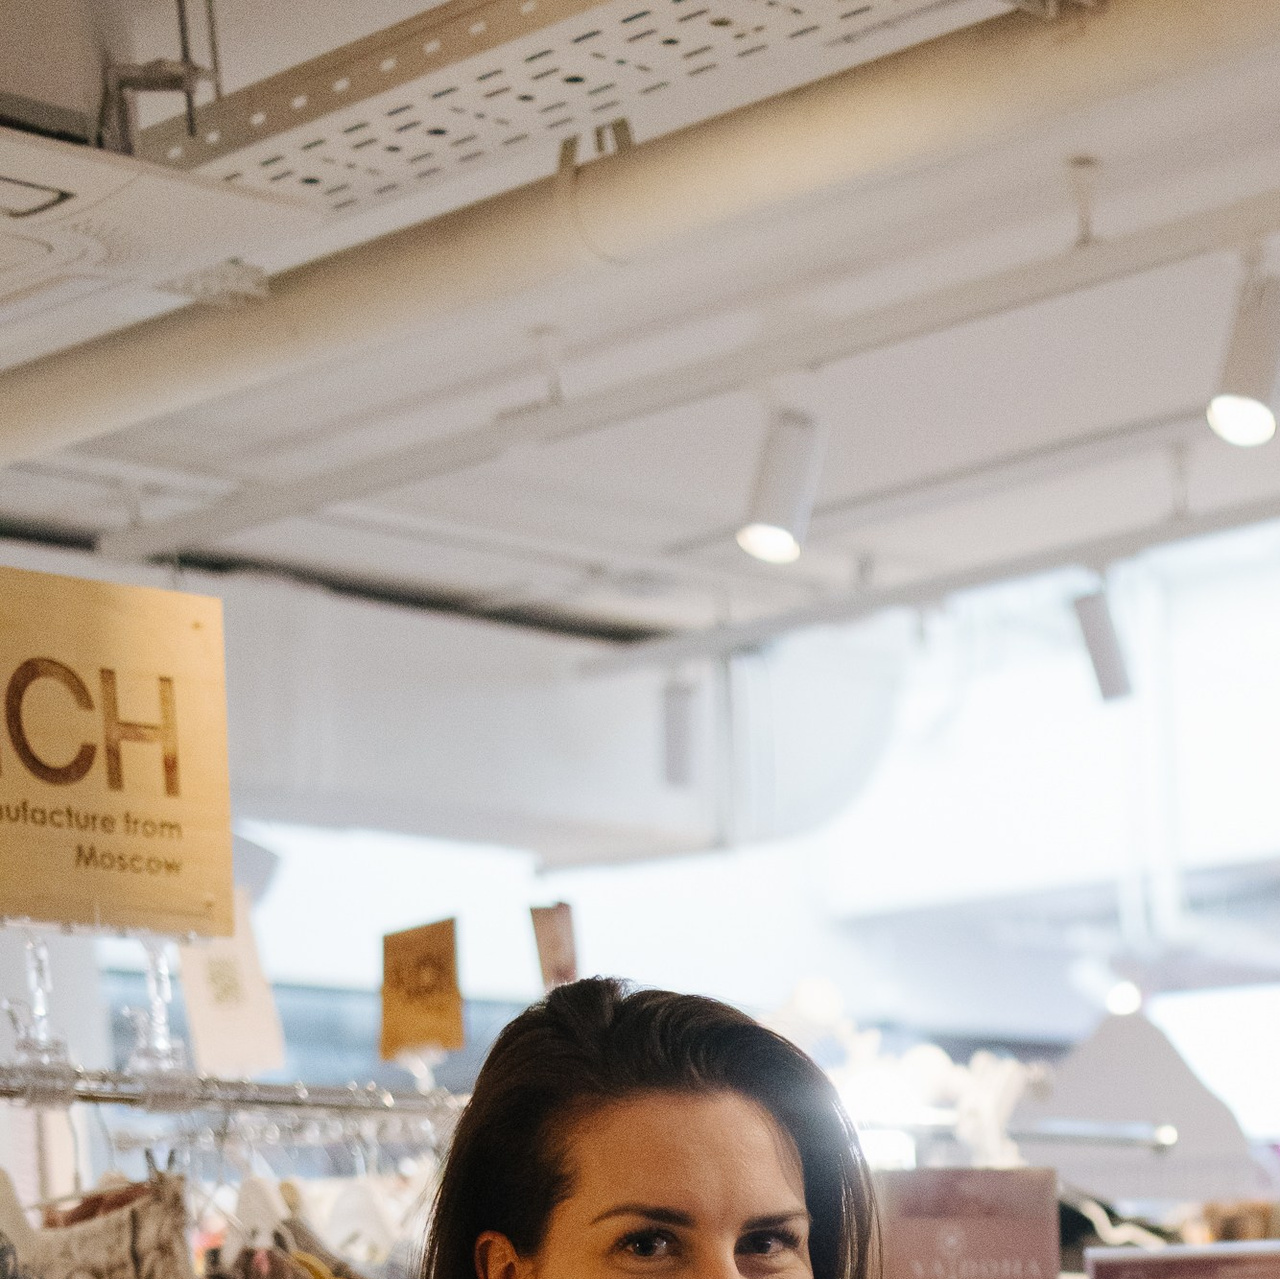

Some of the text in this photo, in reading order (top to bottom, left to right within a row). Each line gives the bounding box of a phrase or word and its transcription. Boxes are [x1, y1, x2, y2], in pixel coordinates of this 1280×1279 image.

[0, 656, 180, 797] CH
[0, 800, 183, 839] ufacture from
[74, 843, 183, 876] Moscow
